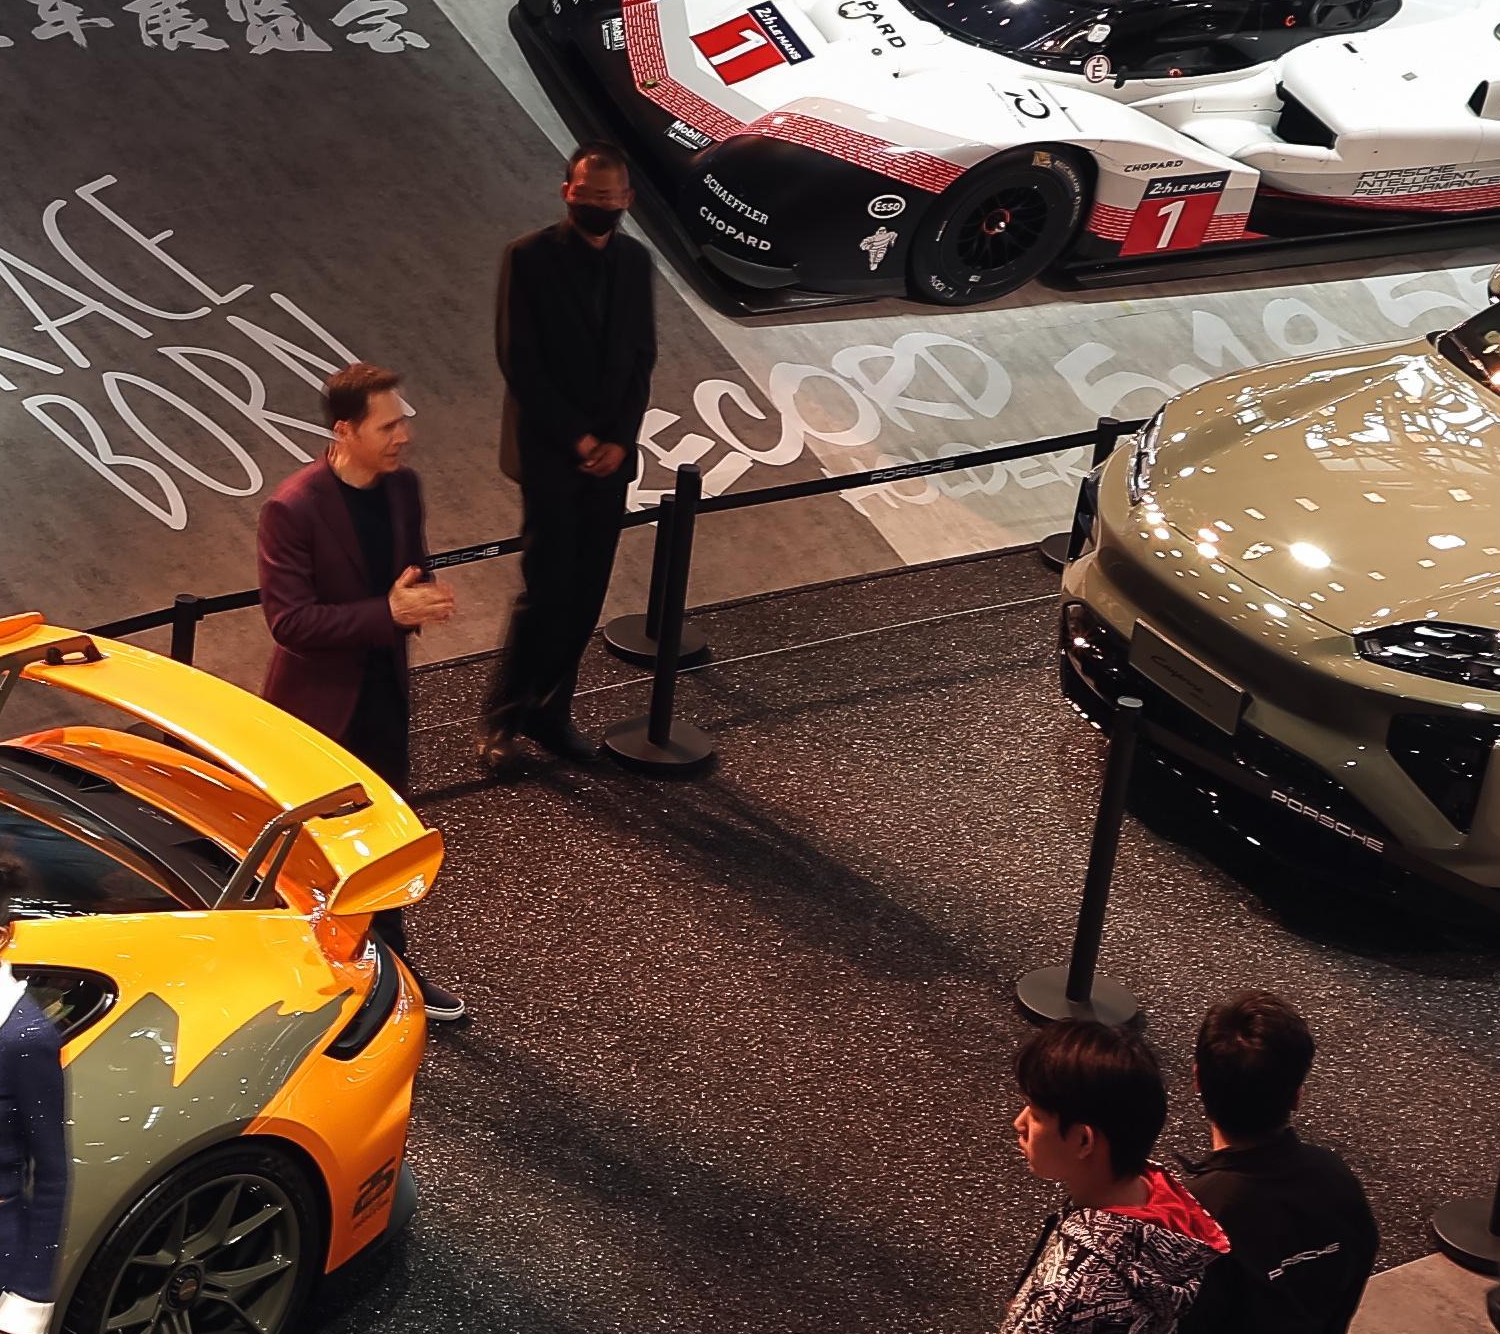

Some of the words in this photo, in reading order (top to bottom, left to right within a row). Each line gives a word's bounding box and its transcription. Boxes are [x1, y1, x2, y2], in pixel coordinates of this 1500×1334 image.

[708, 28, 768, 66] 1
[671, 120, 701, 142] Mobil
[1124, 160, 1184, 173] CHOPARD
[1358, 164, 1457, 180] PORSCHE
[1172, 184, 1188, 193] LE
[1188, 180, 1223, 192] MANS
[1356, 170, 1480, 188] INTELLIGENT
[703, 173, 770, 225] SCHAEFFLER
[699, 205, 772, 251] CHOPARD
[1157, 200, 1186, 249] 1
[870, 461, 955, 482] PORSCHE
[428, 546, 500, 568] RSCHE
[1271, 790, 1384, 853] PORSCHE
[1267, 1242, 1341, 1280] PRSCHE
